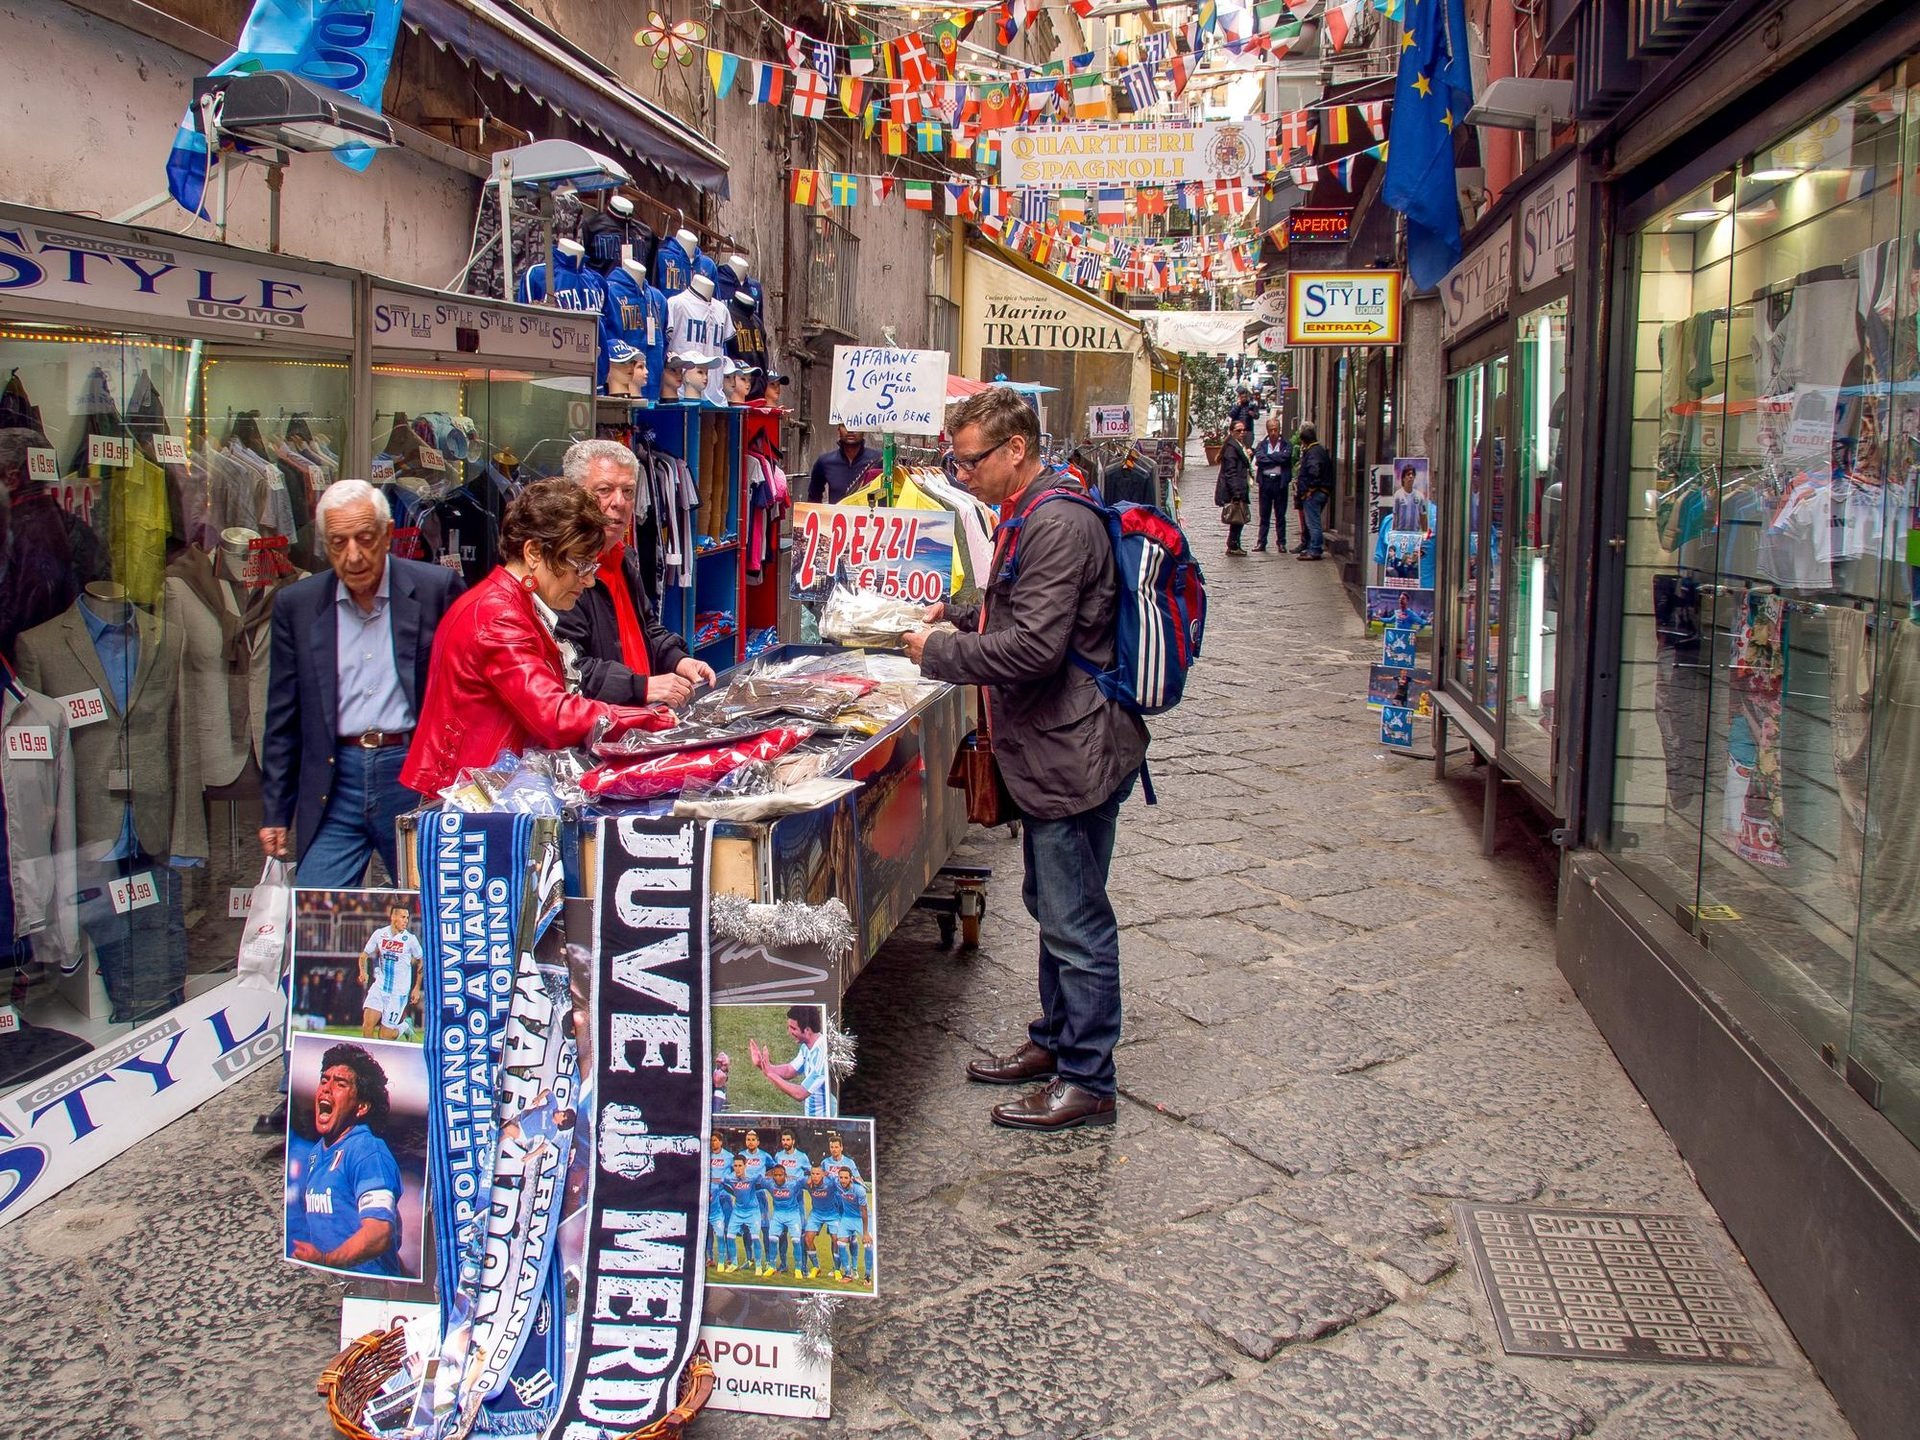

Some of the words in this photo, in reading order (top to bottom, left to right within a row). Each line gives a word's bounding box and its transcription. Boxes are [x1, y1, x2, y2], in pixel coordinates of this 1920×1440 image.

[1011, 133, 1195, 159] QUARTIERI
[1020, 157, 1185, 181] SPAGNOLI
[1293, 218, 1348, 231] APERTO
[1523, 187, 1576, 283] STYLE
[46, 233, 168, 262] Confezioni
[985, 303, 1067, 321] Marino
[1303, 284, 1385, 317] STYLE
[198, 303, 295, 326] UOMO
[374, 304, 432, 333] STYLE
[435, 305, 473, 325] STYLE
[479, 310, 514, 331] STYLE
[519, 316, 550, 334] STYLE
[552, 327, 590, 349] STYLE
[983, 323, 1123, 349] TRATTORIA
[850, 349, 920, 367] AFFARONE
[846, 369, 856, 391] 2
[862, 369, 912, 389] CAMICE
[876, 383, 896, 409] 5
[903, 409, 931, 424] BENE
[801, 511, 819, 590] 2
[828, 512, 919, 577] PEZZI
[858, 568, 875, 589] €
[882, 569, 943, 602] 5.00
[68, 698, 104, 720] 39,99
[19, 732, 48, 752] 19,99
[463, 831, 487, 964] NAPOLI
[440, 812, 465, 1016] JUVENTINO
[488, 878, 512, 1018] TORINO
[609, 815, 695, 1074] JUVE
[466, 972, 488, 1000] A
[388, 1011, 399, 1023] 17
[31, 1023, 171, 1103] Confezioni
[1533, 1217, 1637, 1238] SIPTEL
[477, 1141, 561, 1393] ARMANDO
[726, 1378, 816, 1400] QUARTIERI
